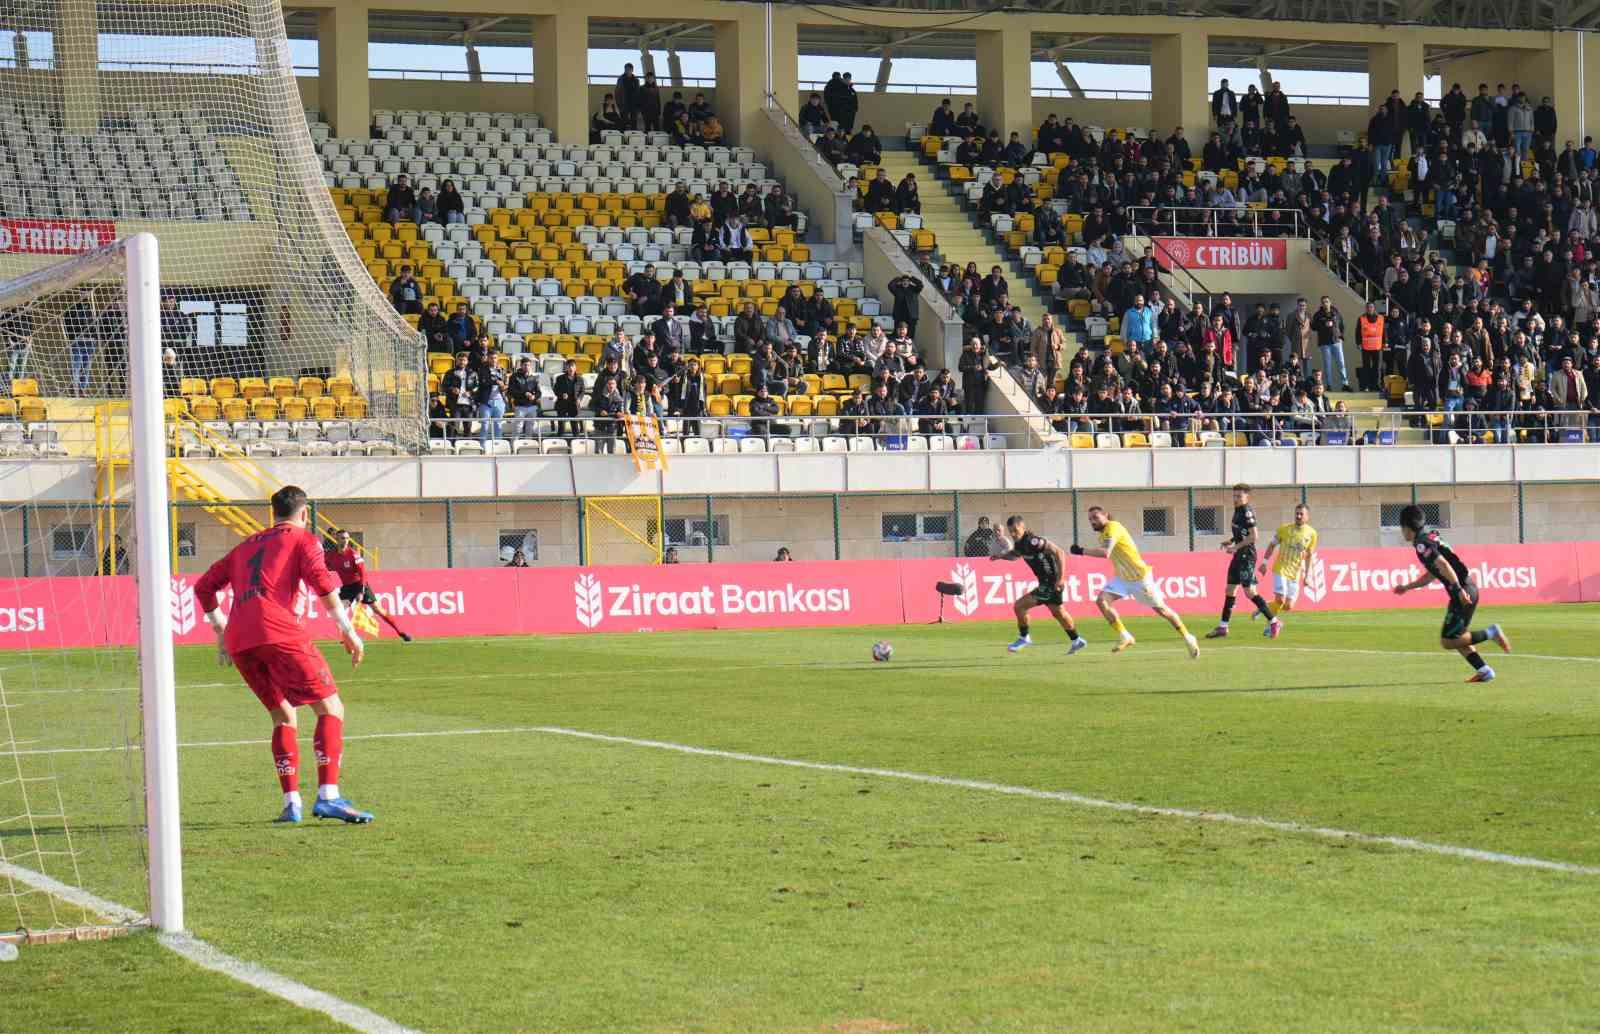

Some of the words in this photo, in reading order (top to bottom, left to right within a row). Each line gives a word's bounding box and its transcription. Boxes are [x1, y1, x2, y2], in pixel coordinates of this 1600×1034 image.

[17, 223, 99, 250] TRİBÜN
[1195, 246, 1206, 266] C
[1208, 242, 1273, 266] TRİBÜN
[246, 543, 265, 585] 1
[1429, 562, 1537, 591] nkası
[608, 584, 716, 617] Ziraat
[720, 583, 851, 614] Bankası
[983, 574, 1082, 605] Zirt
[1087, 572, 1207, 602] Bkası
